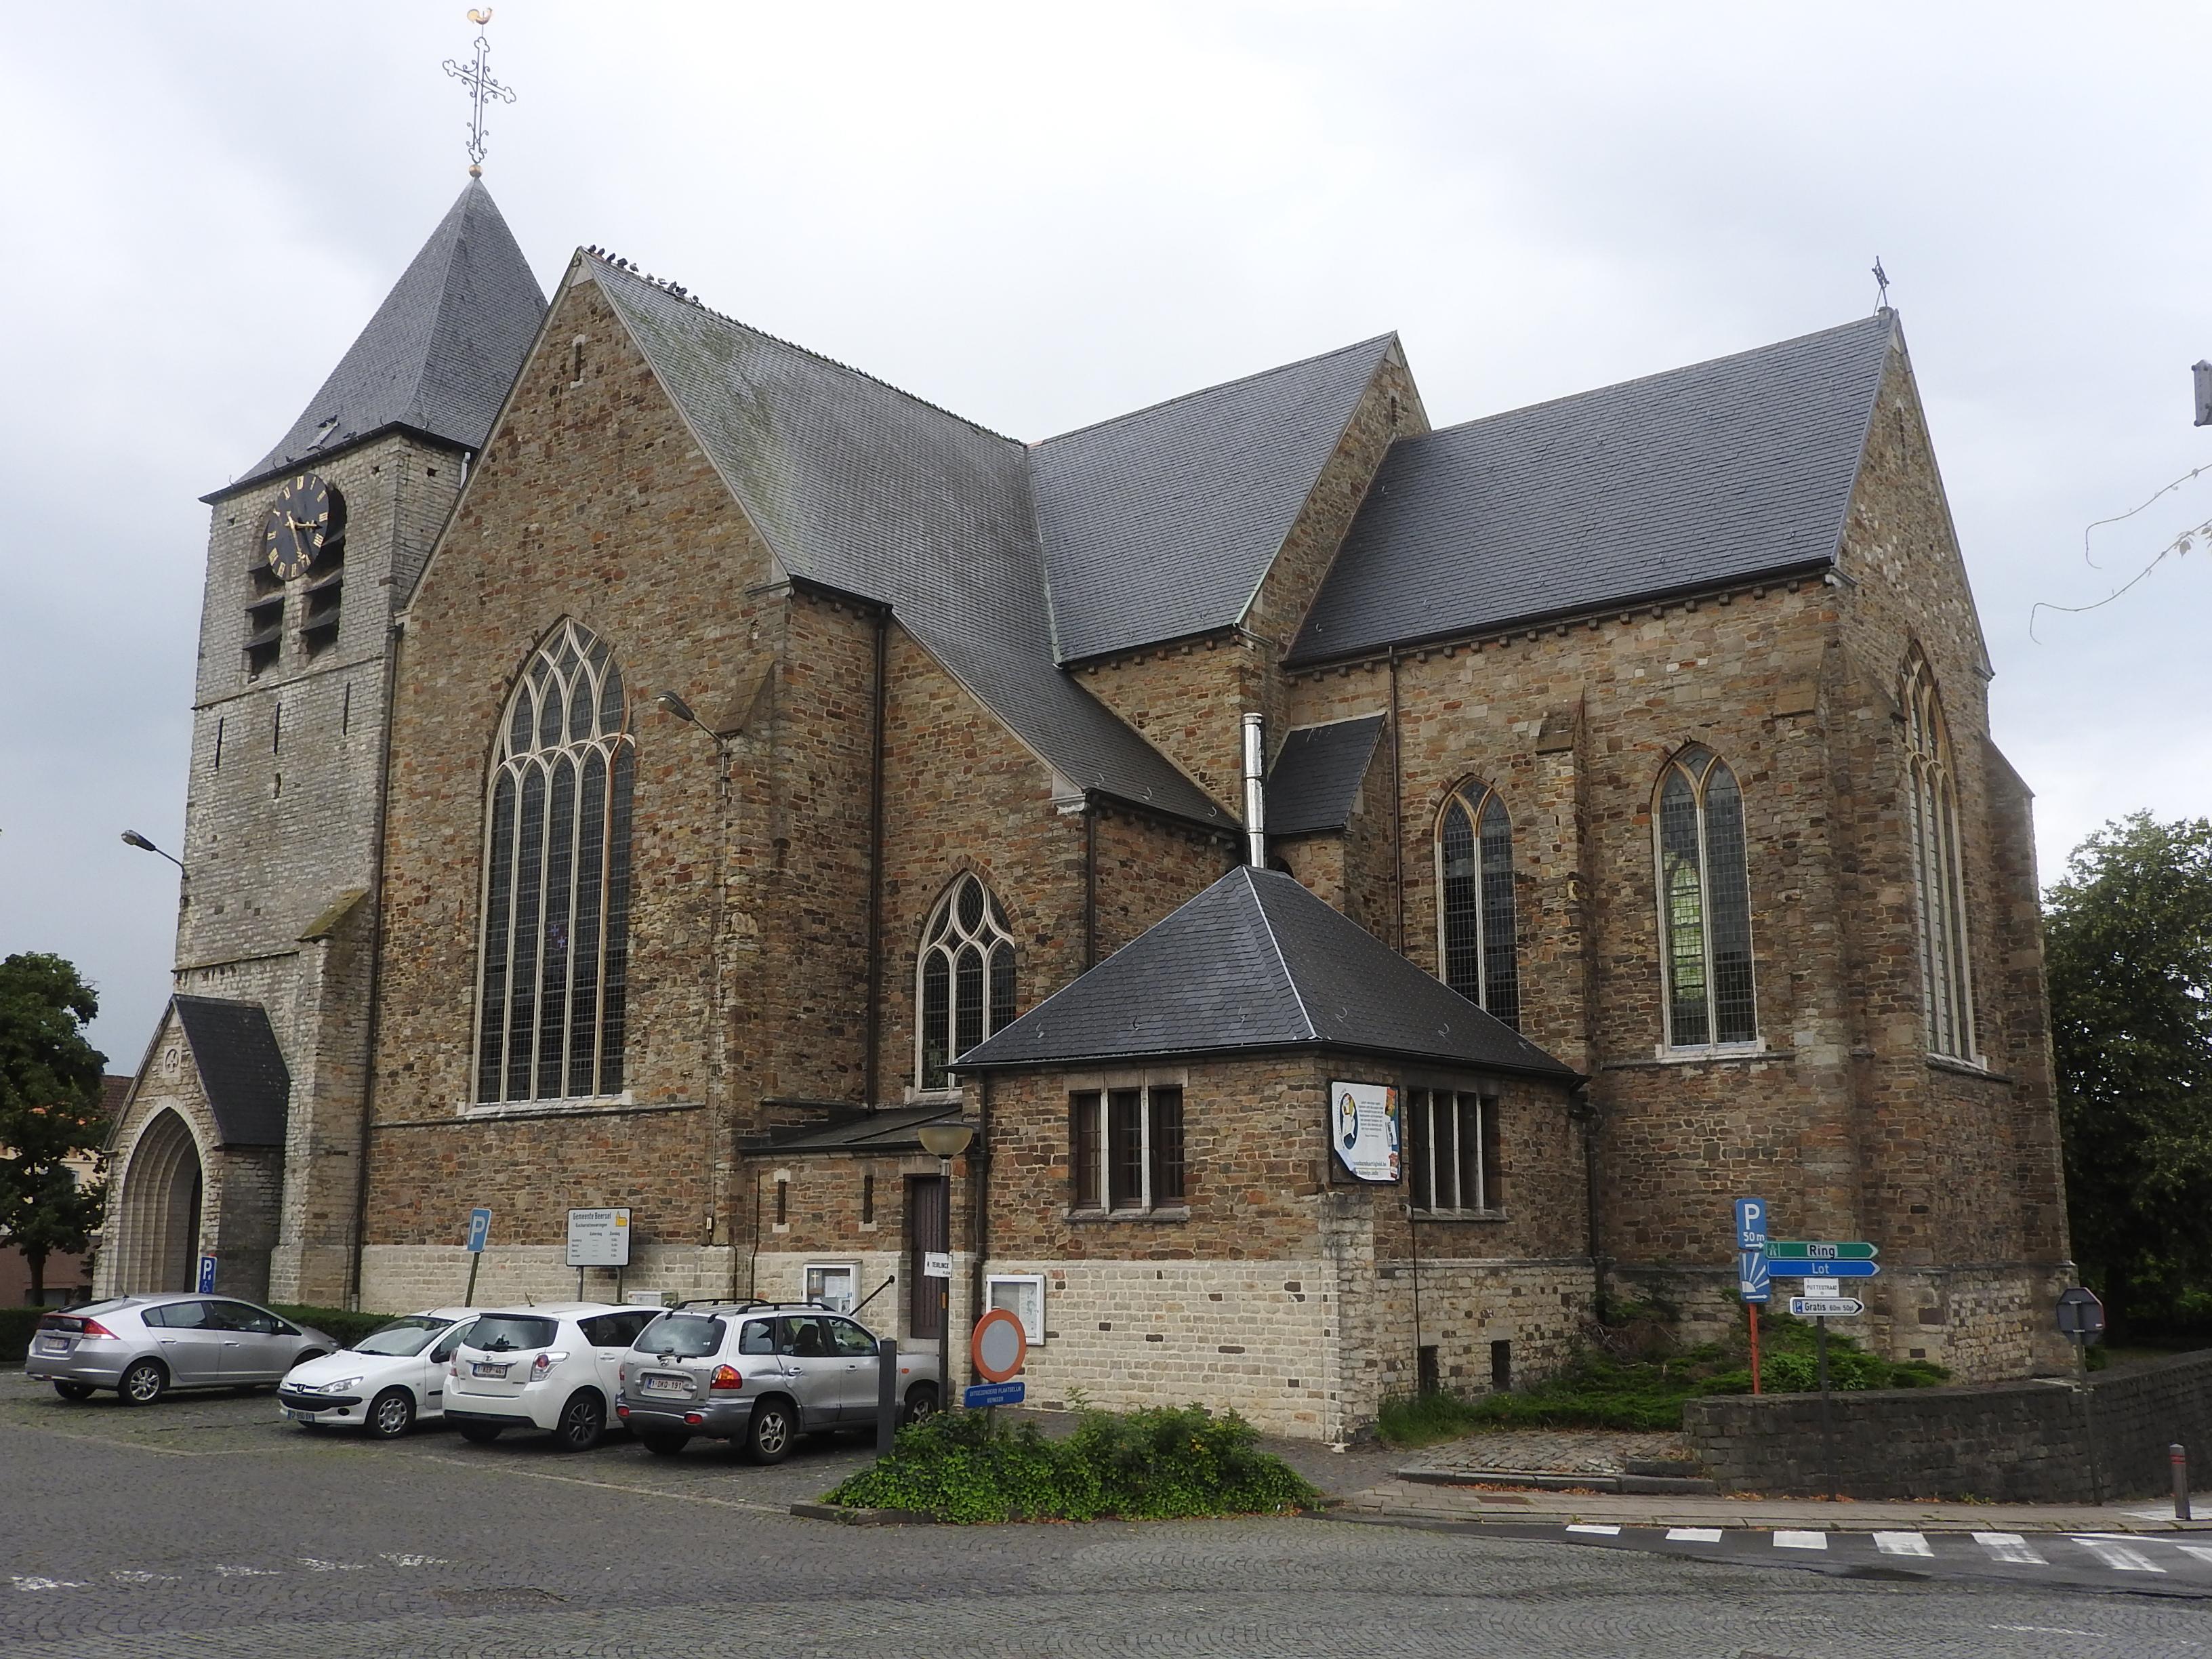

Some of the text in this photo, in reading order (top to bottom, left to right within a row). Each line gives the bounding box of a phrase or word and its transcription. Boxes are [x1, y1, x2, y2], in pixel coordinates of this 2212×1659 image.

[1744, 1204, 1760, 1230] P
[470, 1216, 485, 1245] P
[1743, 1232, 1755, 1242] 50
[1809, 1245, 1835, 1258] Ring
[203, 1260, 212, 1279] P
[1812, 1263, 1830, 1274] Lot
[1805, 1303, 1826, 1311] Gratis
[1843, 1305, 1854, 1313] 50pl
